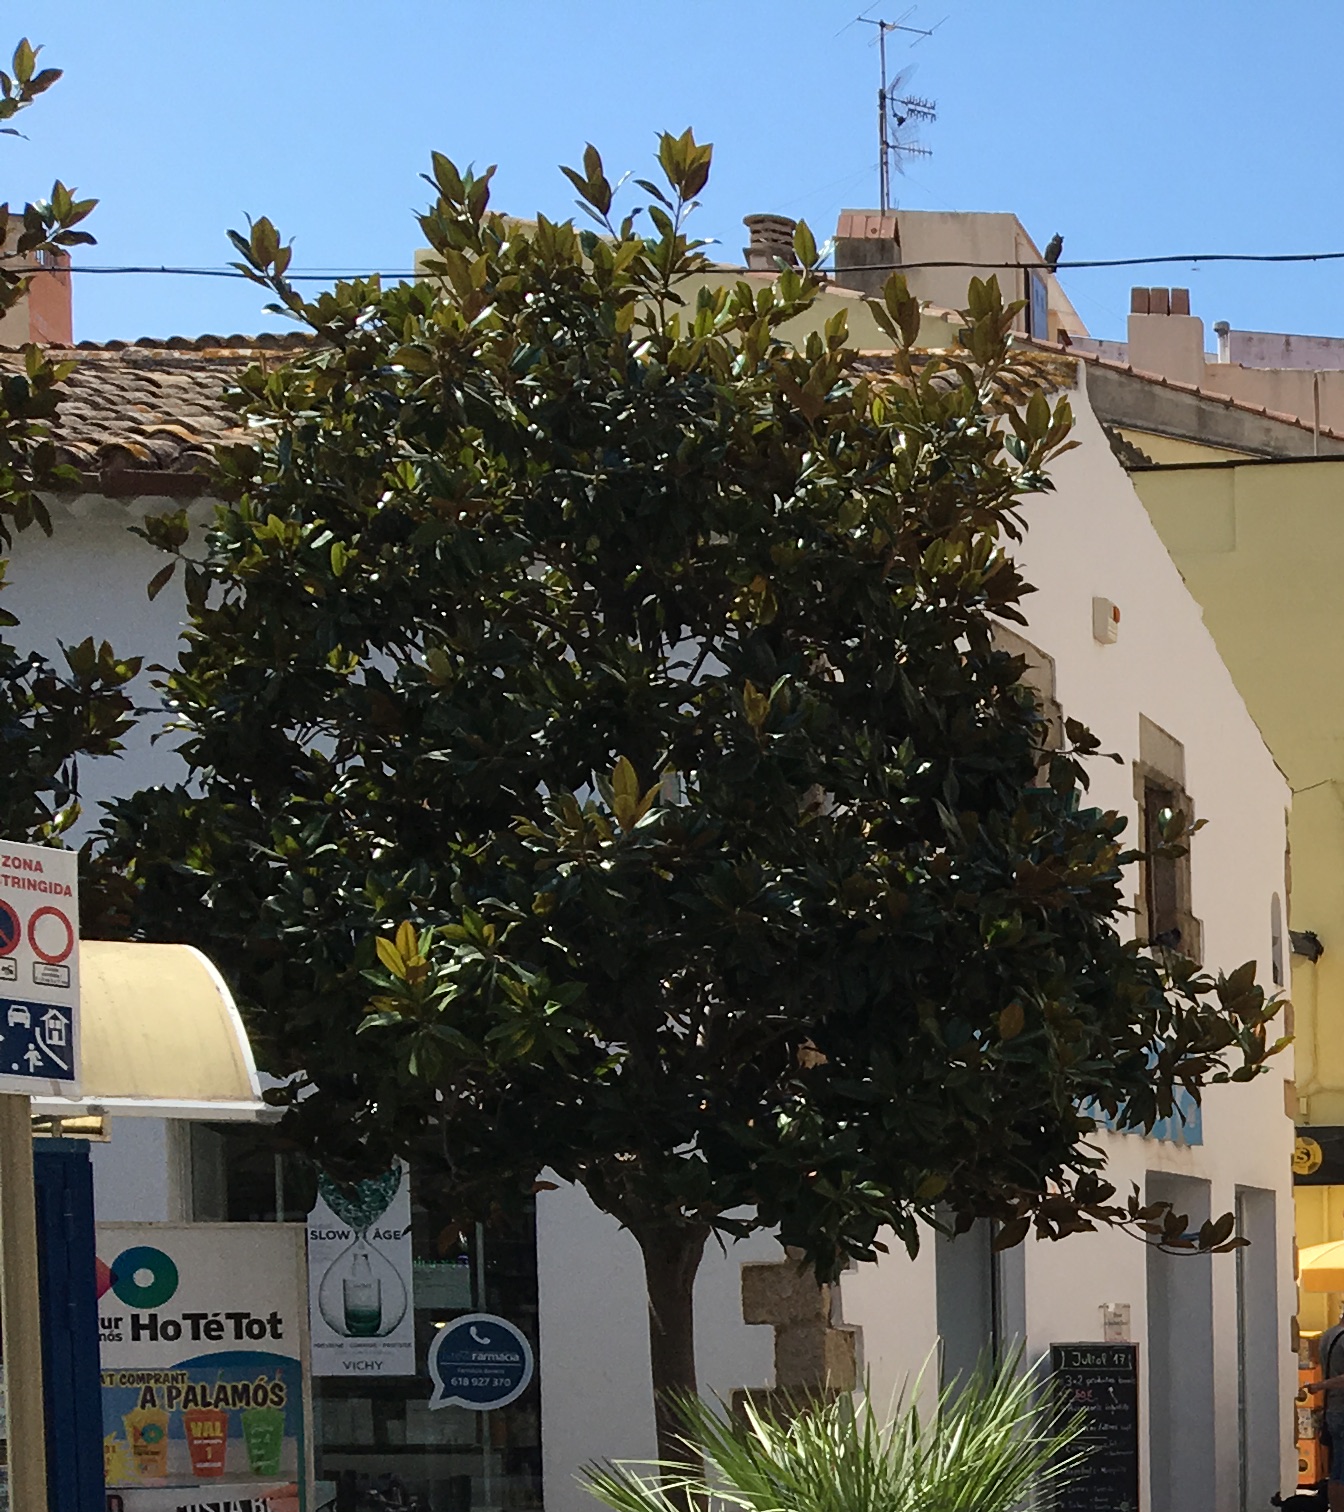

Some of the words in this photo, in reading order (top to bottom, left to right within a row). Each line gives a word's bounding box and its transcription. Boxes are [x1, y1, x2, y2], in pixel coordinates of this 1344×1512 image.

[1, 855, 44, 873] ZONA
[0, 873, 73, 897] TRINGIDA
[310, 1229, 351, 1241] SLOW
[372, 1227, 402, 1241] ÂGE
[99, 1317, 123, 1329] ur
[342, 1360, 384, 1371] VICHY
[119, 1371, 187, 1387] COMPRANT
[450, 1377, 469, 1387] 618
[471, 1377, 490, 1387] 927
[139, 1385, 158, 1410] A
[165, 1376, 287, 1410] PALAMÓS
[189, 1420, 224, 1438] VAL
